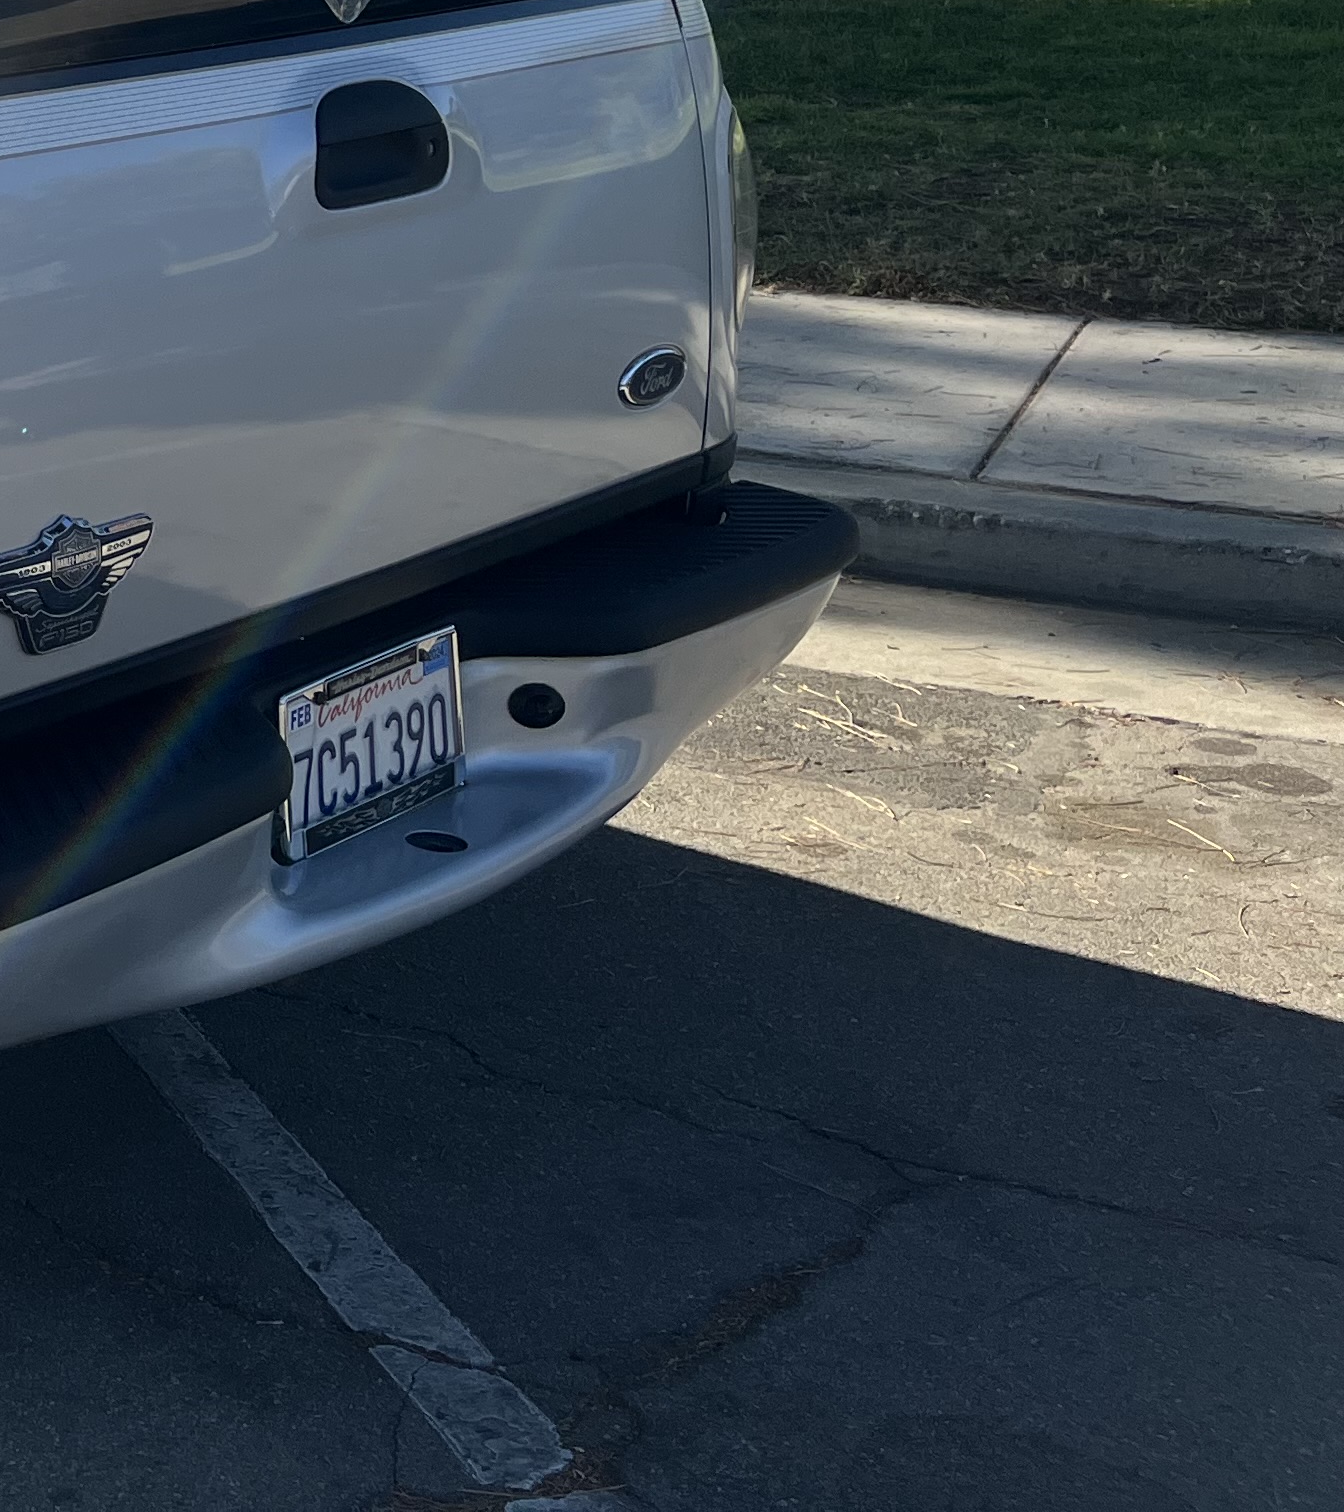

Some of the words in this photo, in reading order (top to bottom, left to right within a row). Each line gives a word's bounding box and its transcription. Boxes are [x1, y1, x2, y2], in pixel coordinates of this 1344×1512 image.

[640, 362, 674, 396] Ford
[105, 538, 133, 553] 2003
[17, 564, 47, 579] 1903
[317, 667, 424, 729] California
[290, 703, 312, 731] FEB
[293, 692, 449, 829] 7C51390
